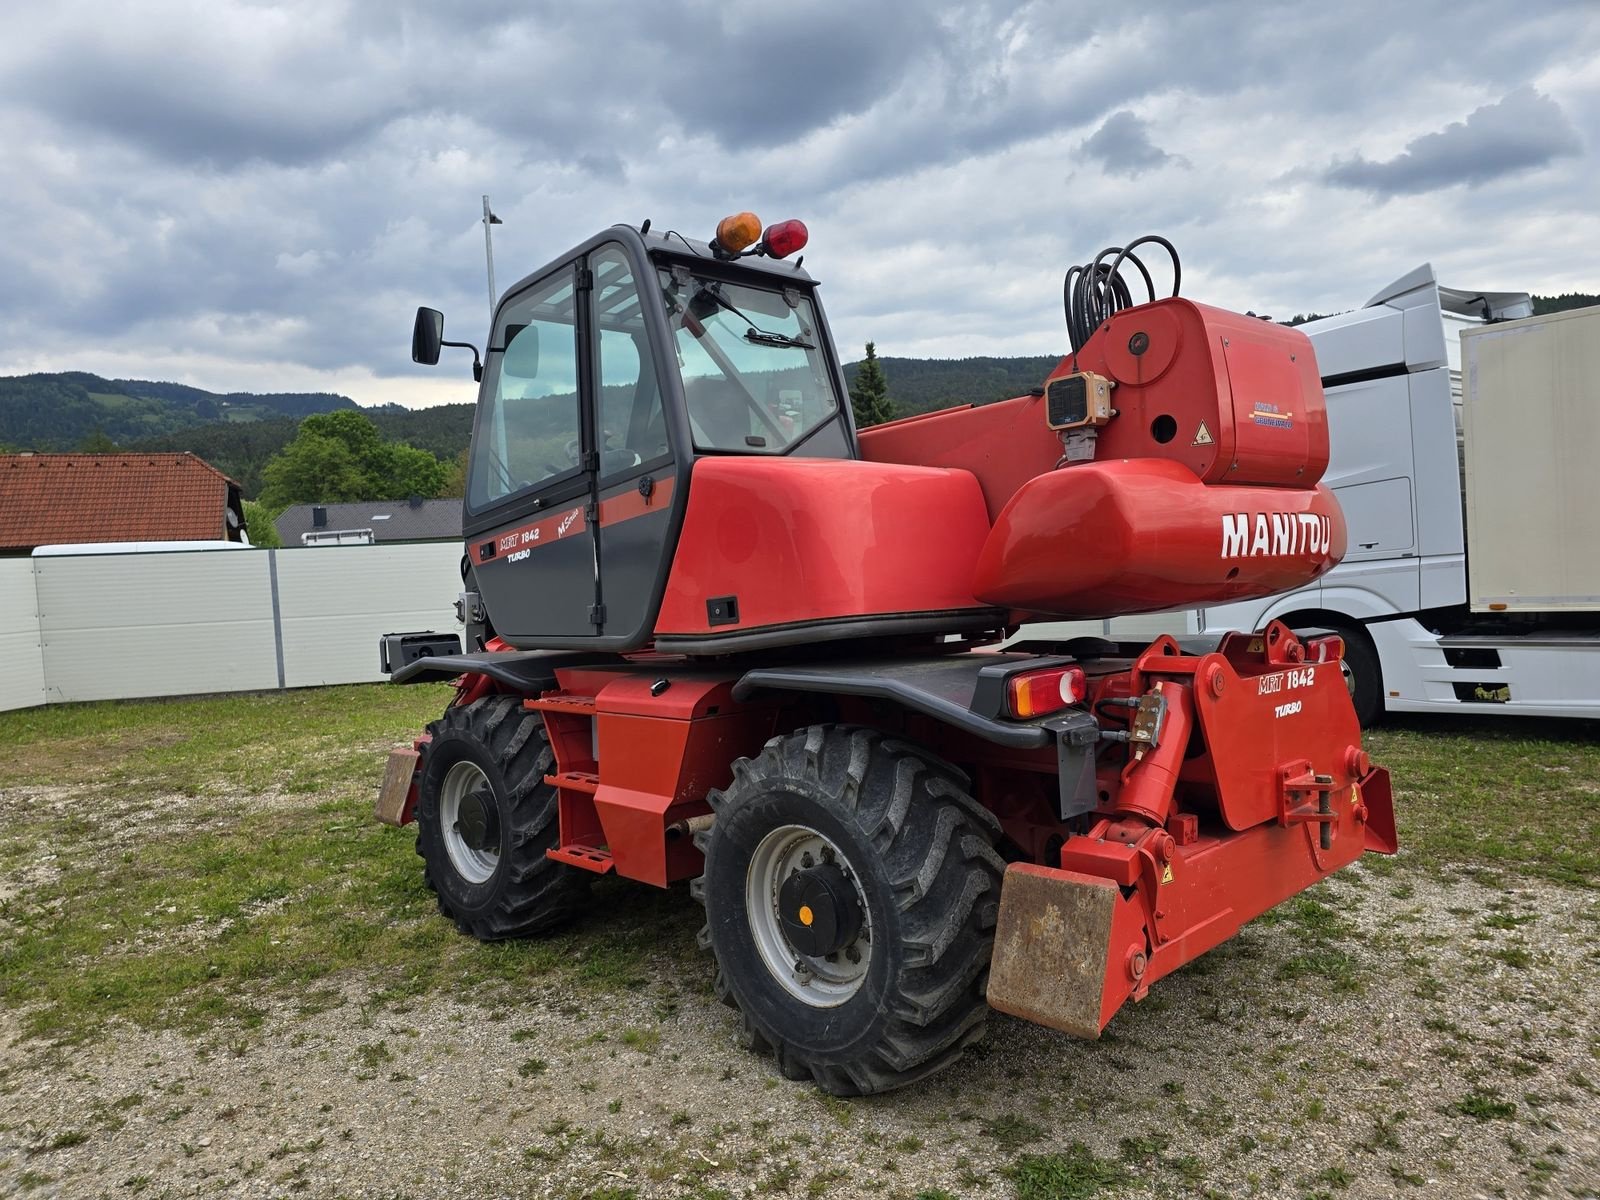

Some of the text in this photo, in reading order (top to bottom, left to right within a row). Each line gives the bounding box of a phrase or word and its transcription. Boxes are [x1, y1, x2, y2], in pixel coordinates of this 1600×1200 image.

[521, 528, 540, 544] 1842
[1220, 512, 1330, 559] MANITOU
[507, 549, 531, 563] TURBO
[1258, 667, 1315, 695] MRT 1842
[1274, 700, 1302, 718] TURBO
